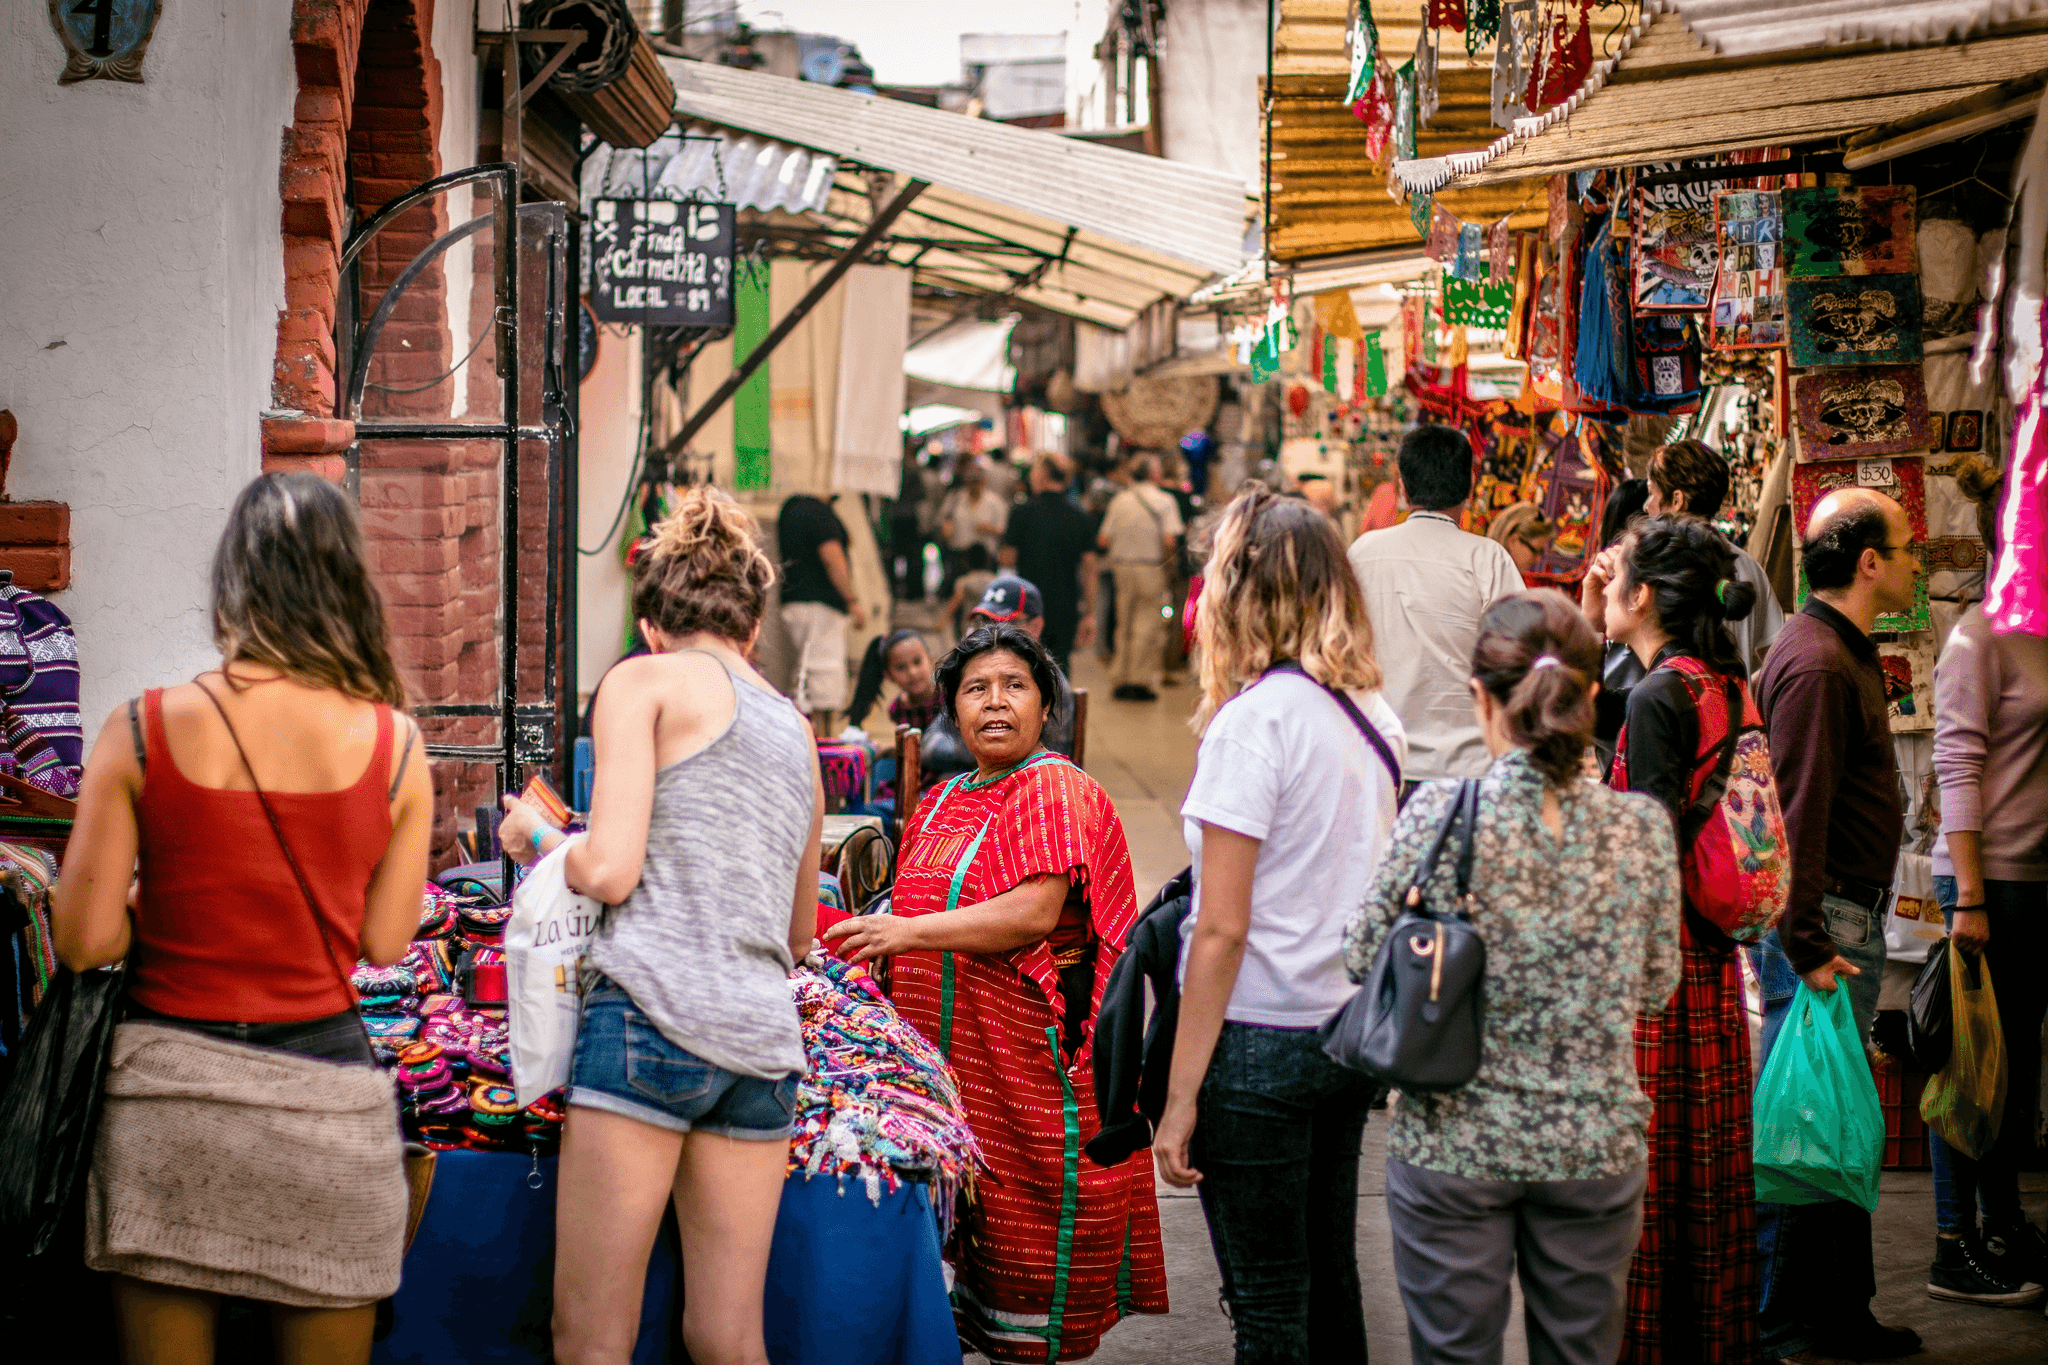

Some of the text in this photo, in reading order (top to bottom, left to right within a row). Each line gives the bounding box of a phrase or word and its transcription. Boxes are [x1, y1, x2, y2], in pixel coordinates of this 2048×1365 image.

[613, 285, 668, 308] LOCAL
[1860, 461, 1891, 482] $30
[533, 920, 562, 948] La
